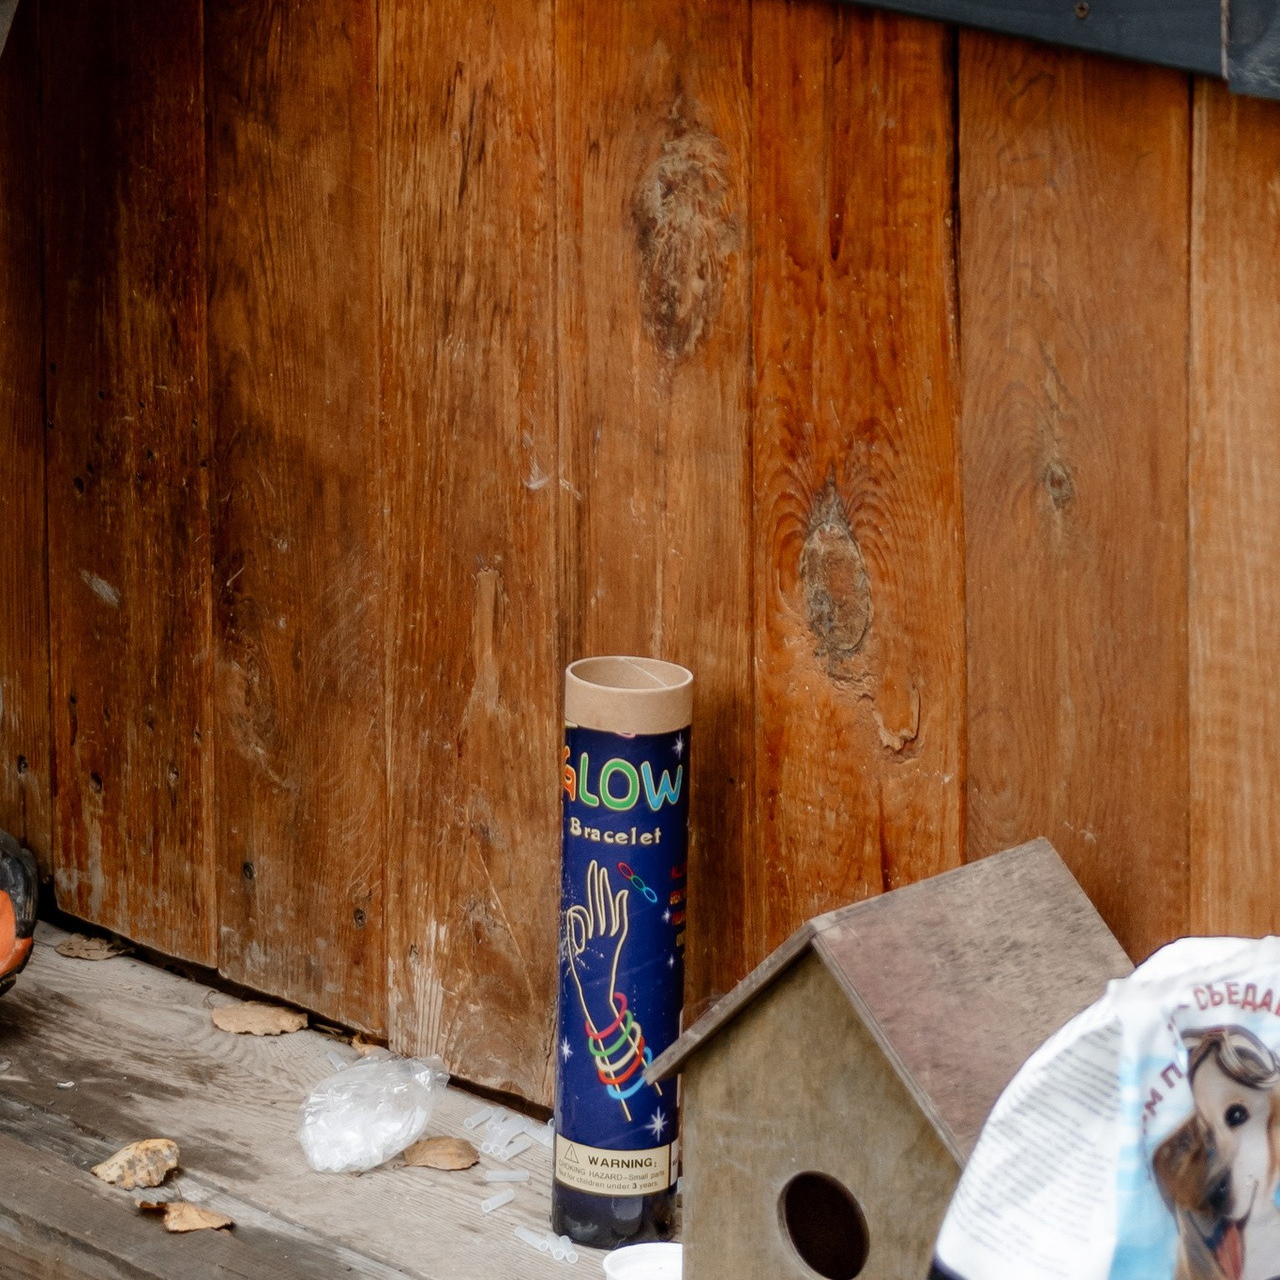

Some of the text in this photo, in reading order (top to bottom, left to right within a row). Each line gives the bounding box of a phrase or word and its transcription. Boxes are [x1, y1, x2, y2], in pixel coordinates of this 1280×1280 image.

[570, 816, 662, 845] Bracelet
[587, 1155, 657, 1169] WARNING:
[576, 1176, 605, 1188] children
[606, 1182, 630, 1190] under
[632, 1182, 638, 1190] 3
